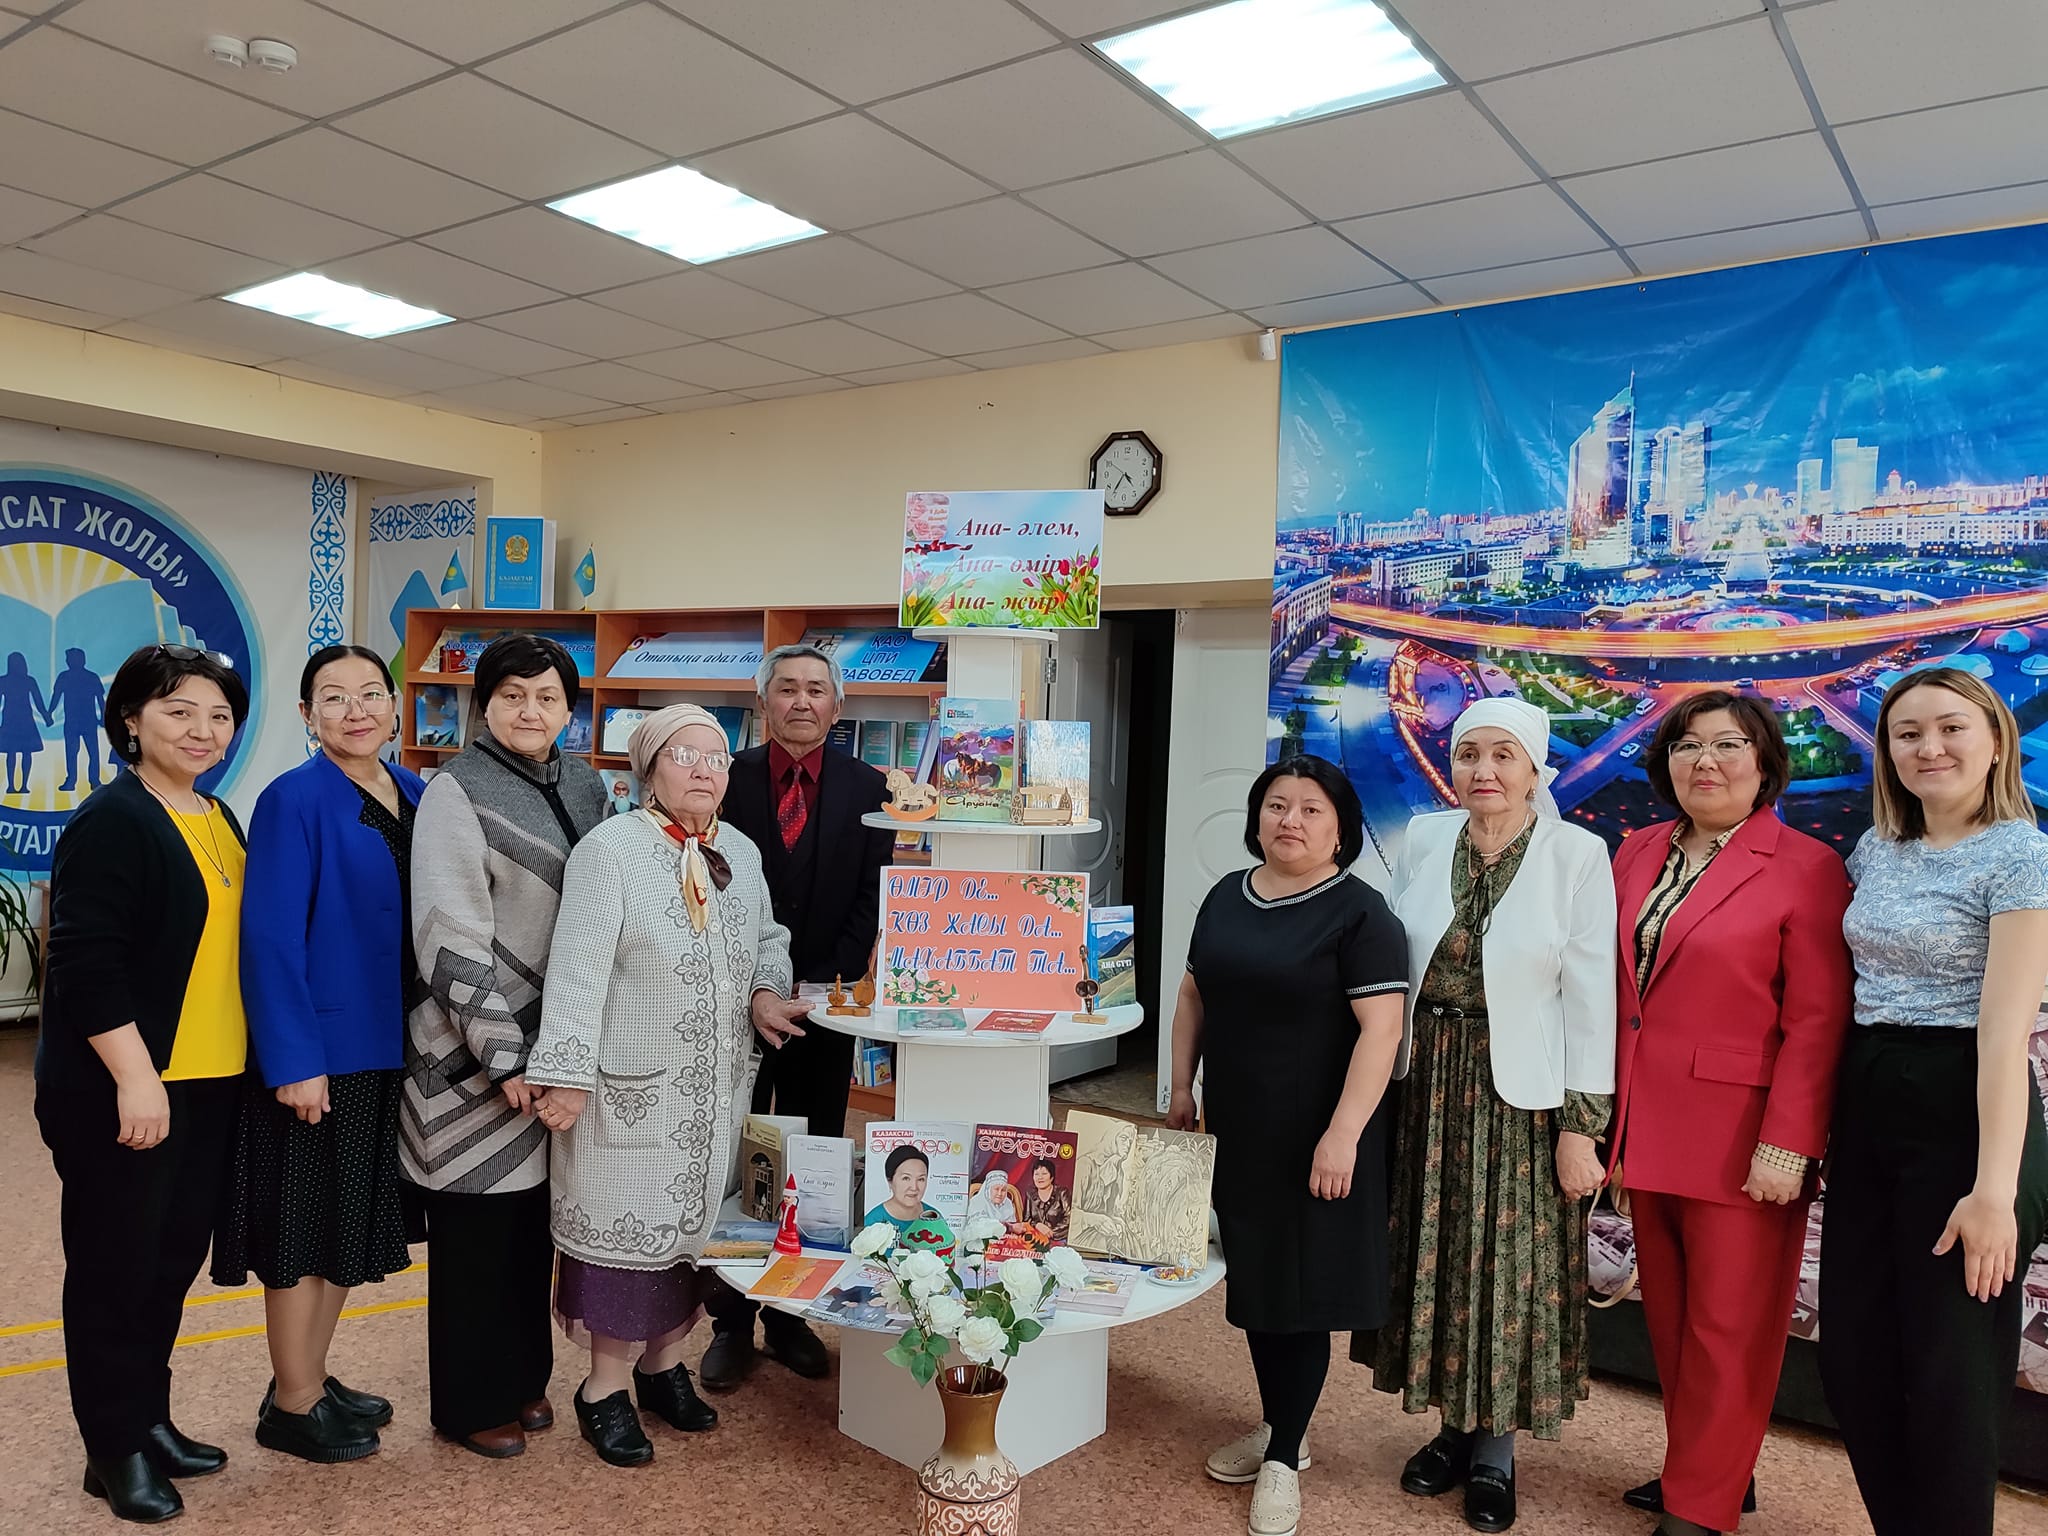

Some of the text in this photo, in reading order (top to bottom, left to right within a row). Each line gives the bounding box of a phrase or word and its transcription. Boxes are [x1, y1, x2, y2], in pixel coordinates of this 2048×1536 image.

[956, 518, 1080, 538] Ана- әлем,
[0, 495, 189, 587] САТ ЖОЛЫ»
[952, 554, 1003, 573] Ана-
[940, 592, 995, 610] Ана-
[871, 634, 906, 649] ҚАО
[634, 651, 700, 665] Отаныңа
[703, 652, 737, 664] адал
[861, 652, 899, 666] ЦПИ
[0, 820, 67, 855] РТАЛ
[942, 912, 1008, 936] ЖАСЫ
